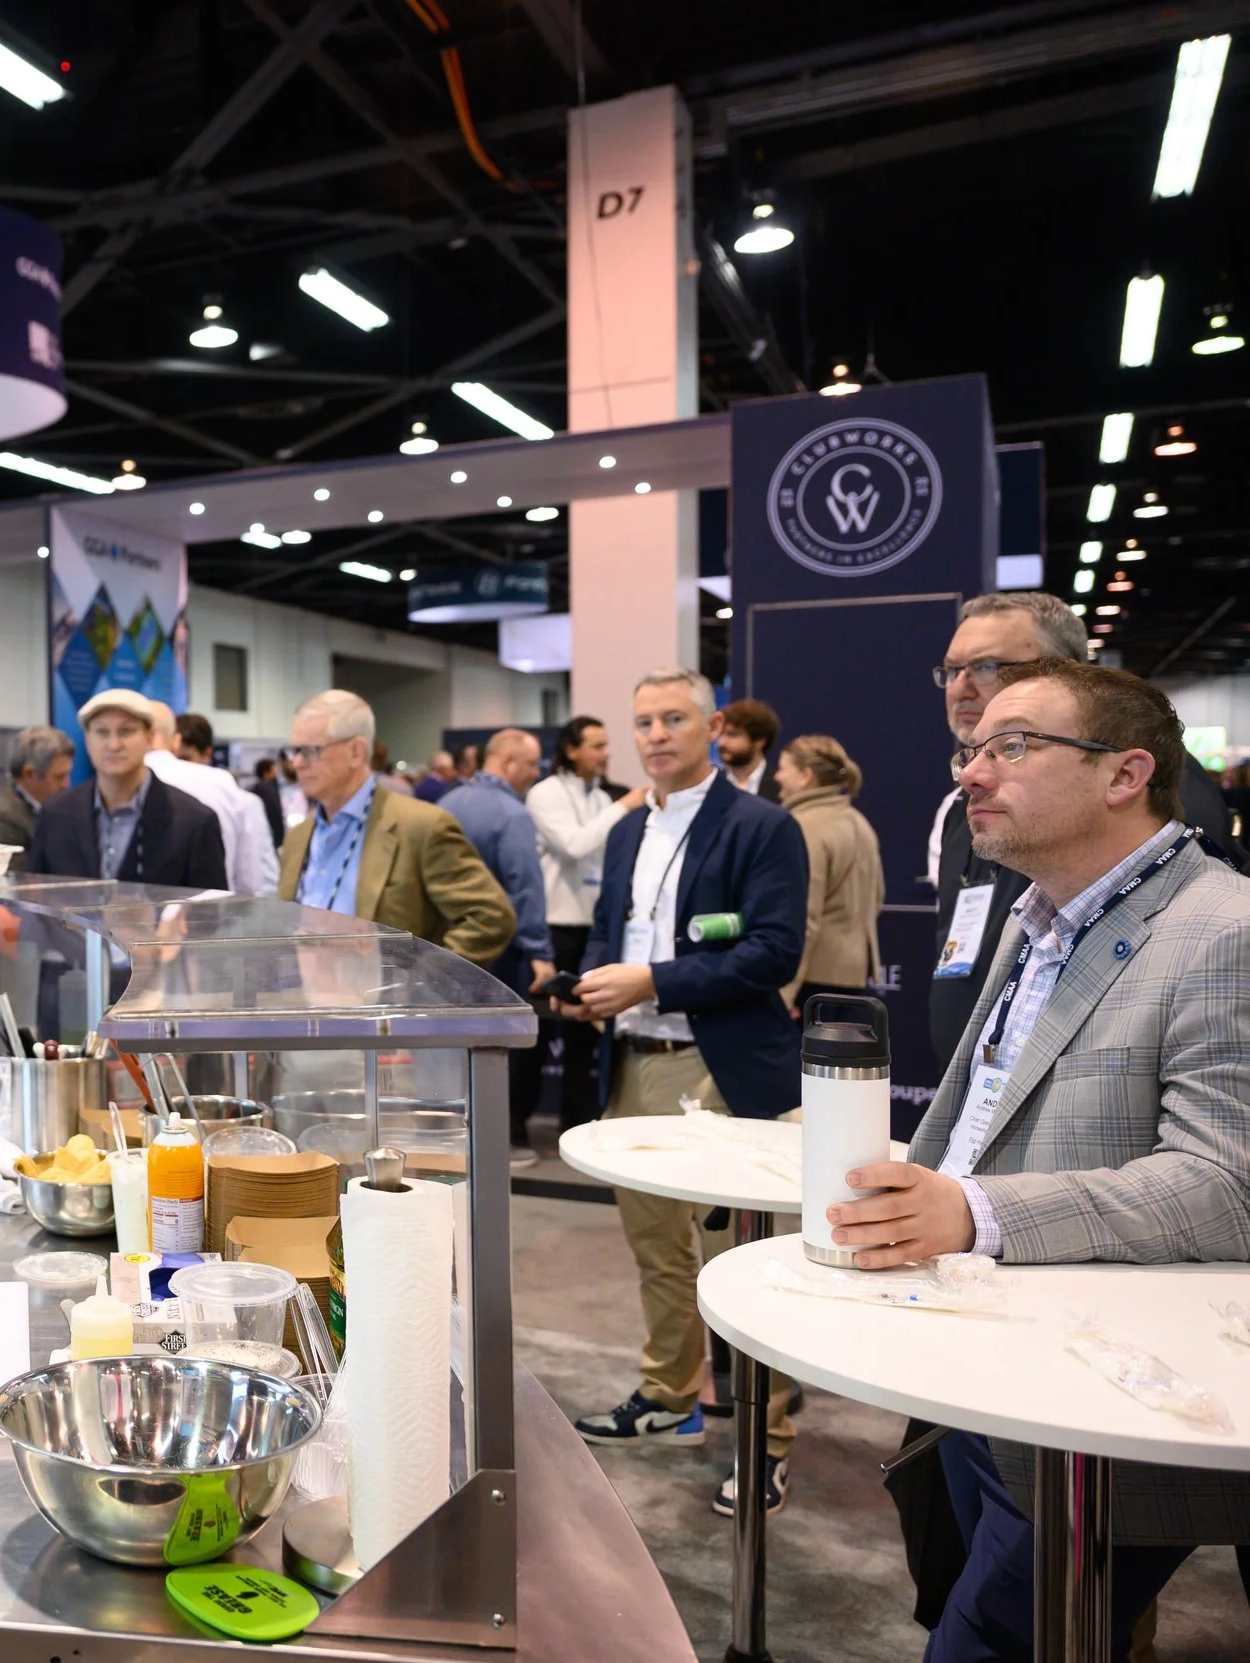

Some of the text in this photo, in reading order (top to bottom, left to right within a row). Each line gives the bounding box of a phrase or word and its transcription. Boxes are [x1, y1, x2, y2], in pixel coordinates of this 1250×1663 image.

[597, 185, 644, 220] D7
[790, 430, 919, 475] CLUBWORKS
[1155, 848, 1176, 865] CMAA
[1119, 877, 1142, 895] CMAA
[1084, 908, 1104, 927] CMAA
[1017, 944, 1031, 964] CMAA
[1061, 944, 1074, 965] CMAA
[1003, 981, 1017, 1001] CMAA
[983, 1098, 998, 1108] AND
[161, 1342, 187, 1350] STREE
